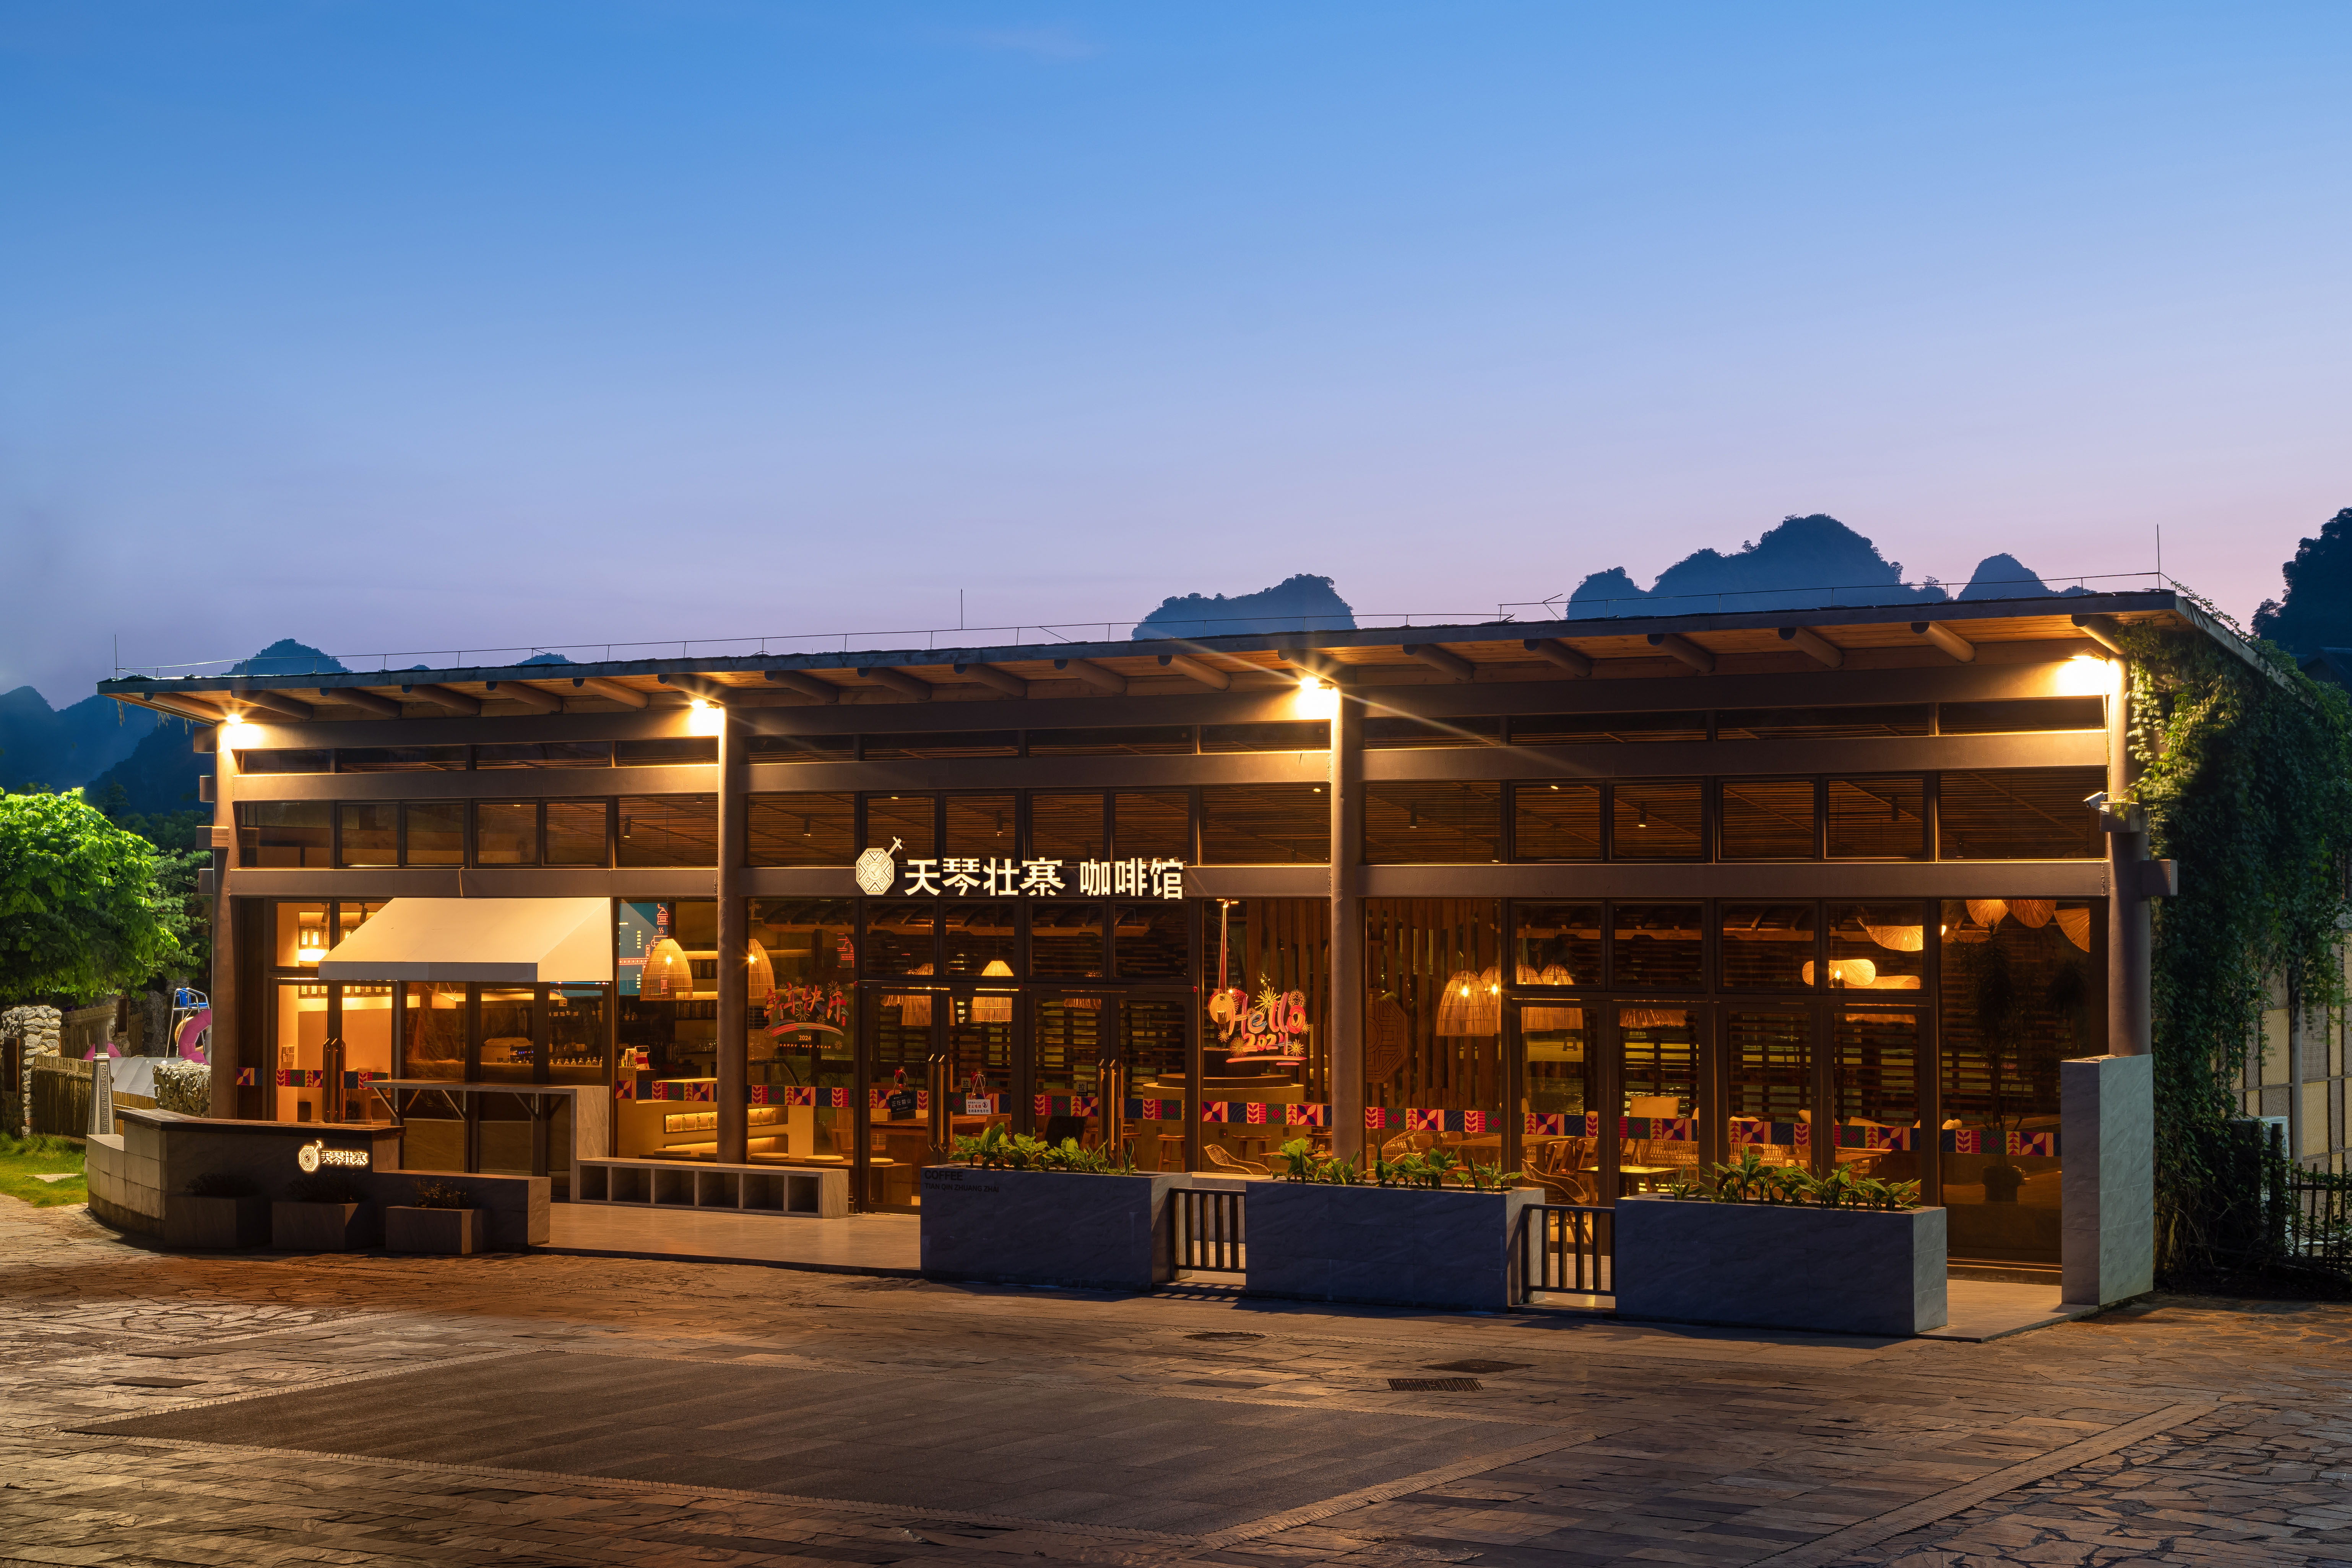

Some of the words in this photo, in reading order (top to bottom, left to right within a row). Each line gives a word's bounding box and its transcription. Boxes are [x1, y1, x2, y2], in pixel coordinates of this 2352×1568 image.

[905, 857, 1066, 897] 天琴壮寨
[1080, 857, 1184, 899] 咖啡馆
[764, 981, 849, 1022] 新年快乐
[1227, 991, 1306, 1037] Hello
[1242, 1032, 1293, 1056] 2024
[891, 1098, 911, 1107] 正在营业
[321, 1150, 369, 1166] 天琴壮寨
[924, 1170, 963, 1181] COFFEE
[941, 1183, 953, 1191] QIN
